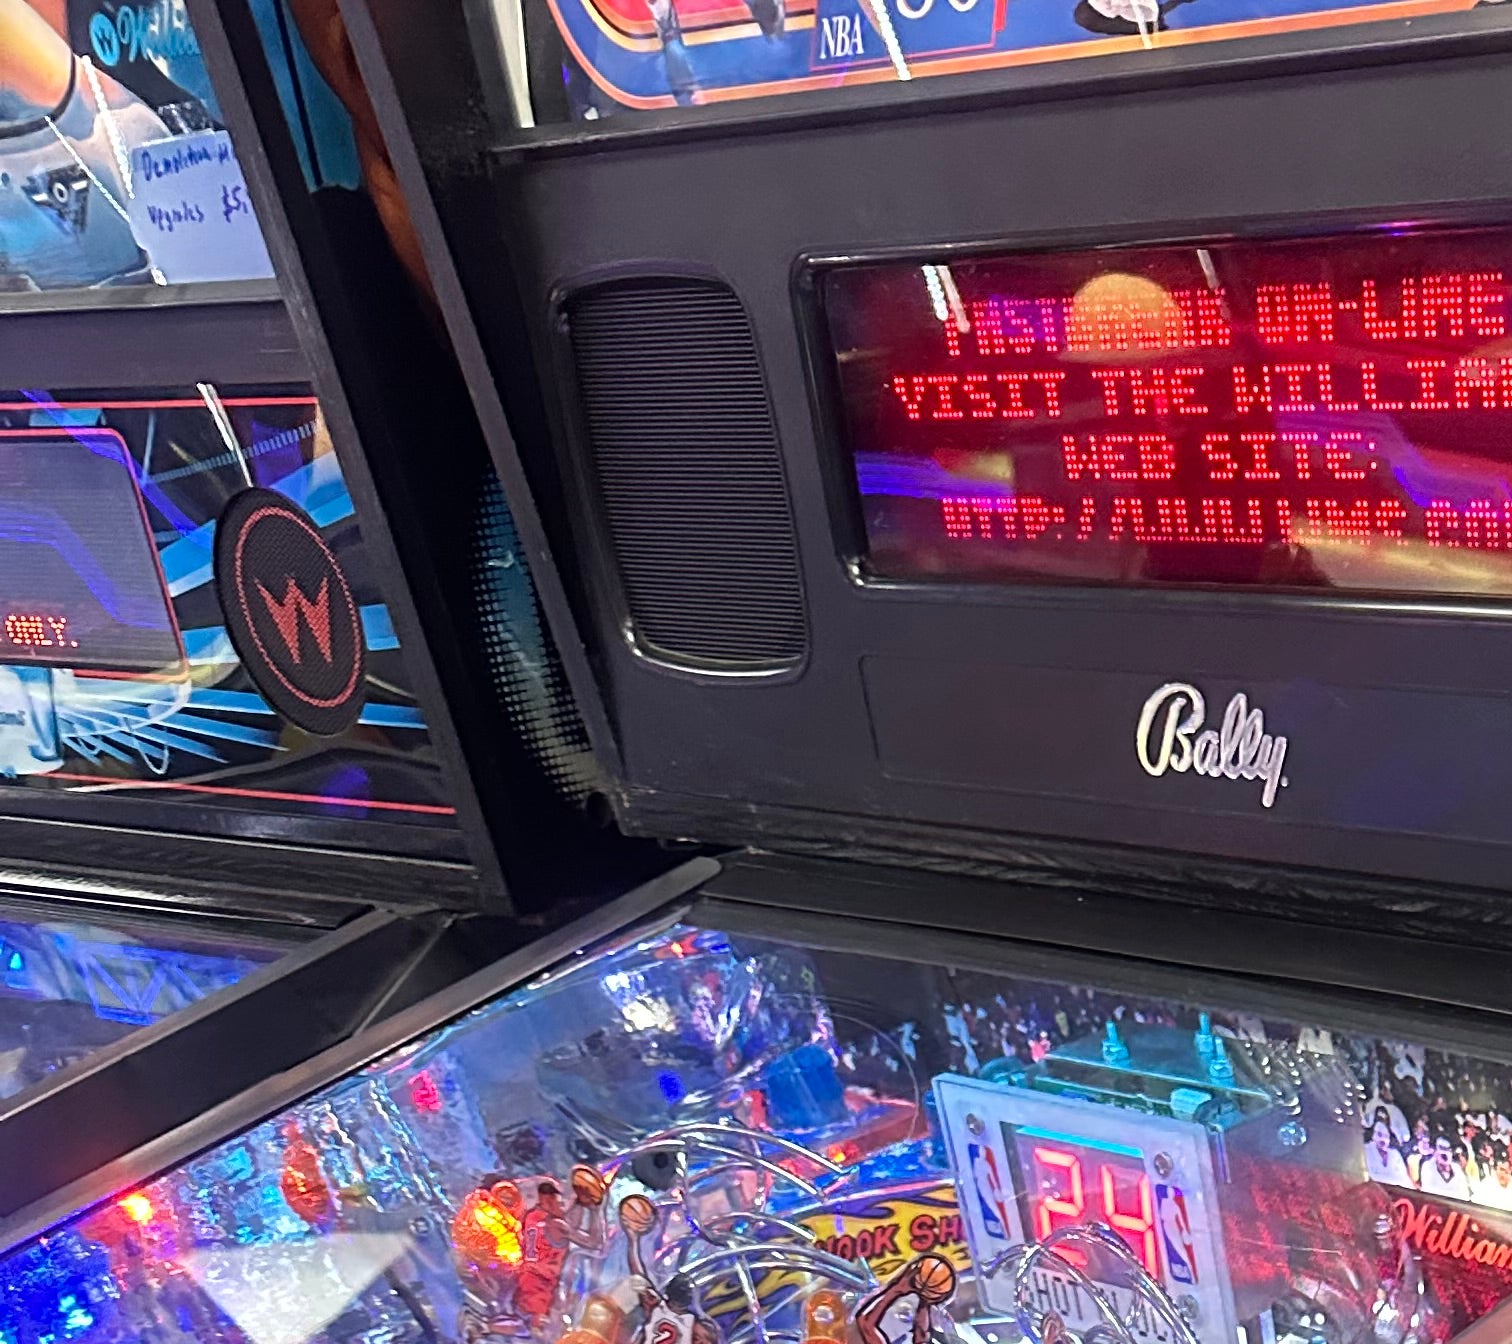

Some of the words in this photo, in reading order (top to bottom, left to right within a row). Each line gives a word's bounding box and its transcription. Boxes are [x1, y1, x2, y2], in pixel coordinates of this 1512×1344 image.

[819, 17, 864, 60] NBA
[1256, 271, 1505, 344] ON-LINE
[893, 371, 1066, 420] VISIT
[1091, 365, 1209, 416] THE
[1062, 433, 1176, 481] WEB
[1200, 431, 1378, 481] SITE:
[1034, 1146, 1159, 1282] 24
